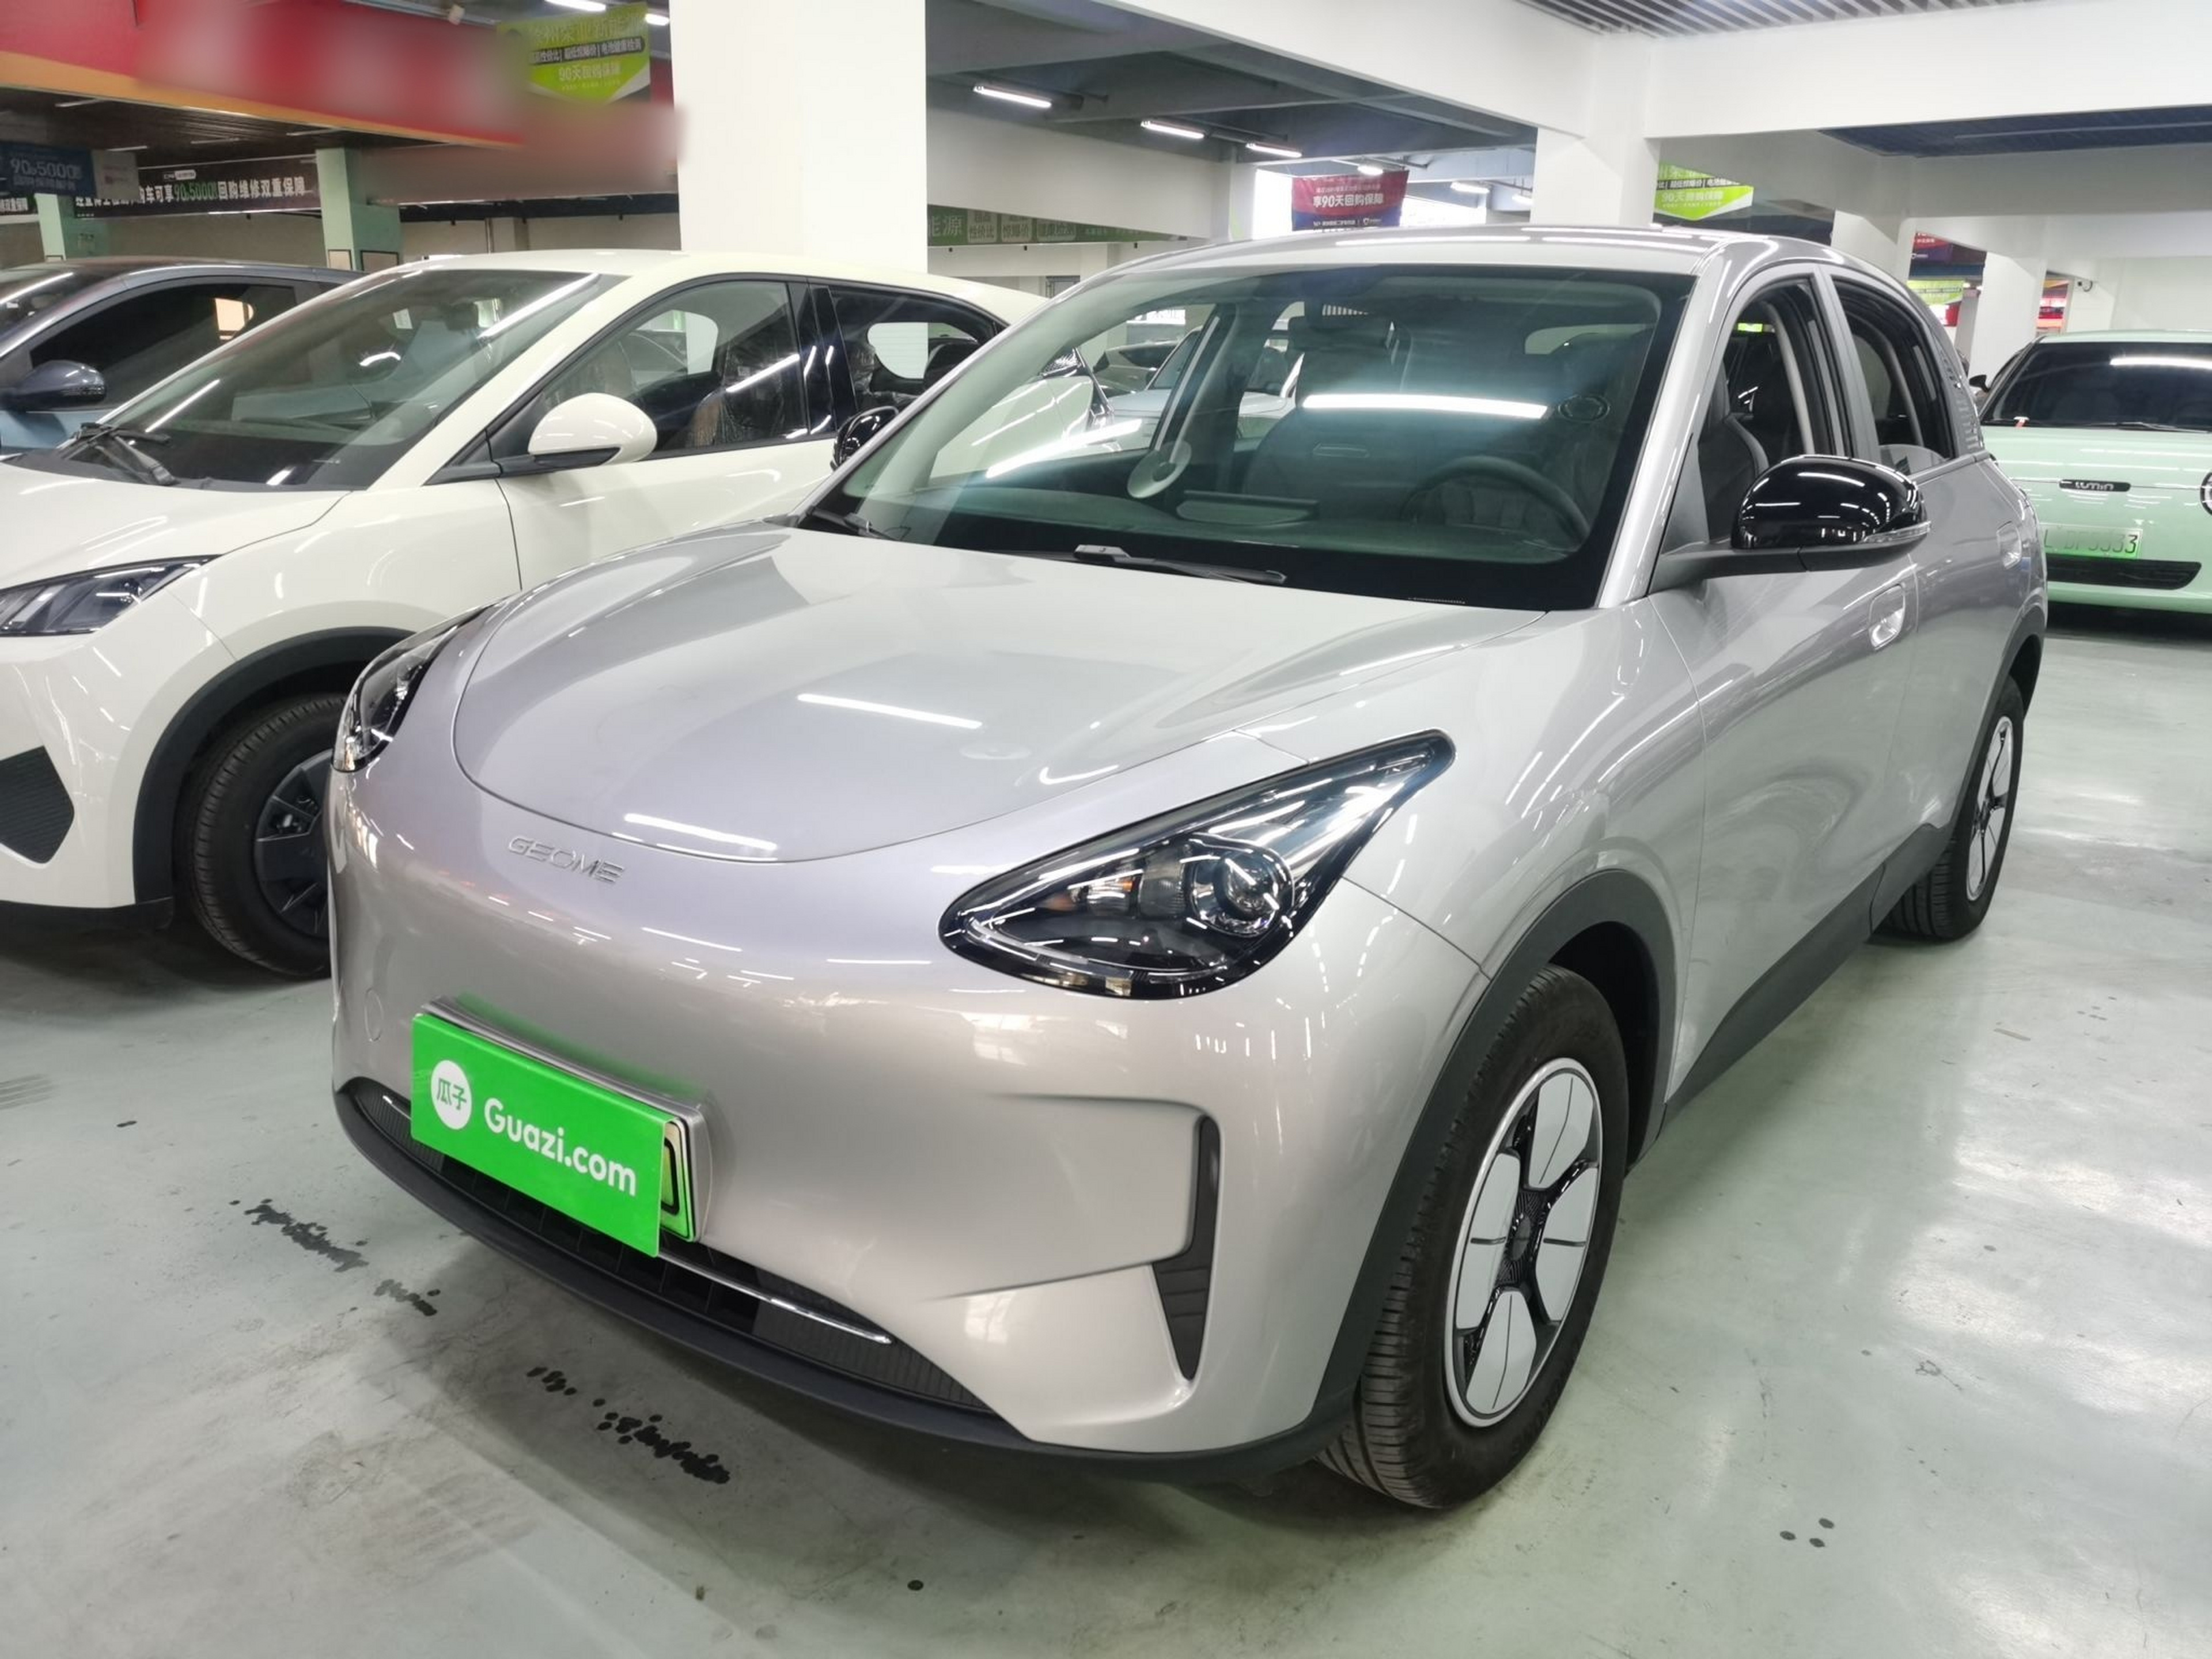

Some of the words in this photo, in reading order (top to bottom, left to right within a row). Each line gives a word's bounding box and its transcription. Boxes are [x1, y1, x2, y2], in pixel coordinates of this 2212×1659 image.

[1313, 192, 1383, 208] 享90天回购保障
[509, 836, 626, 884] GEOME
[437, 1078, 467, 1111] 瓜子
[484, 1097, 636, 1197] Guazi.com
